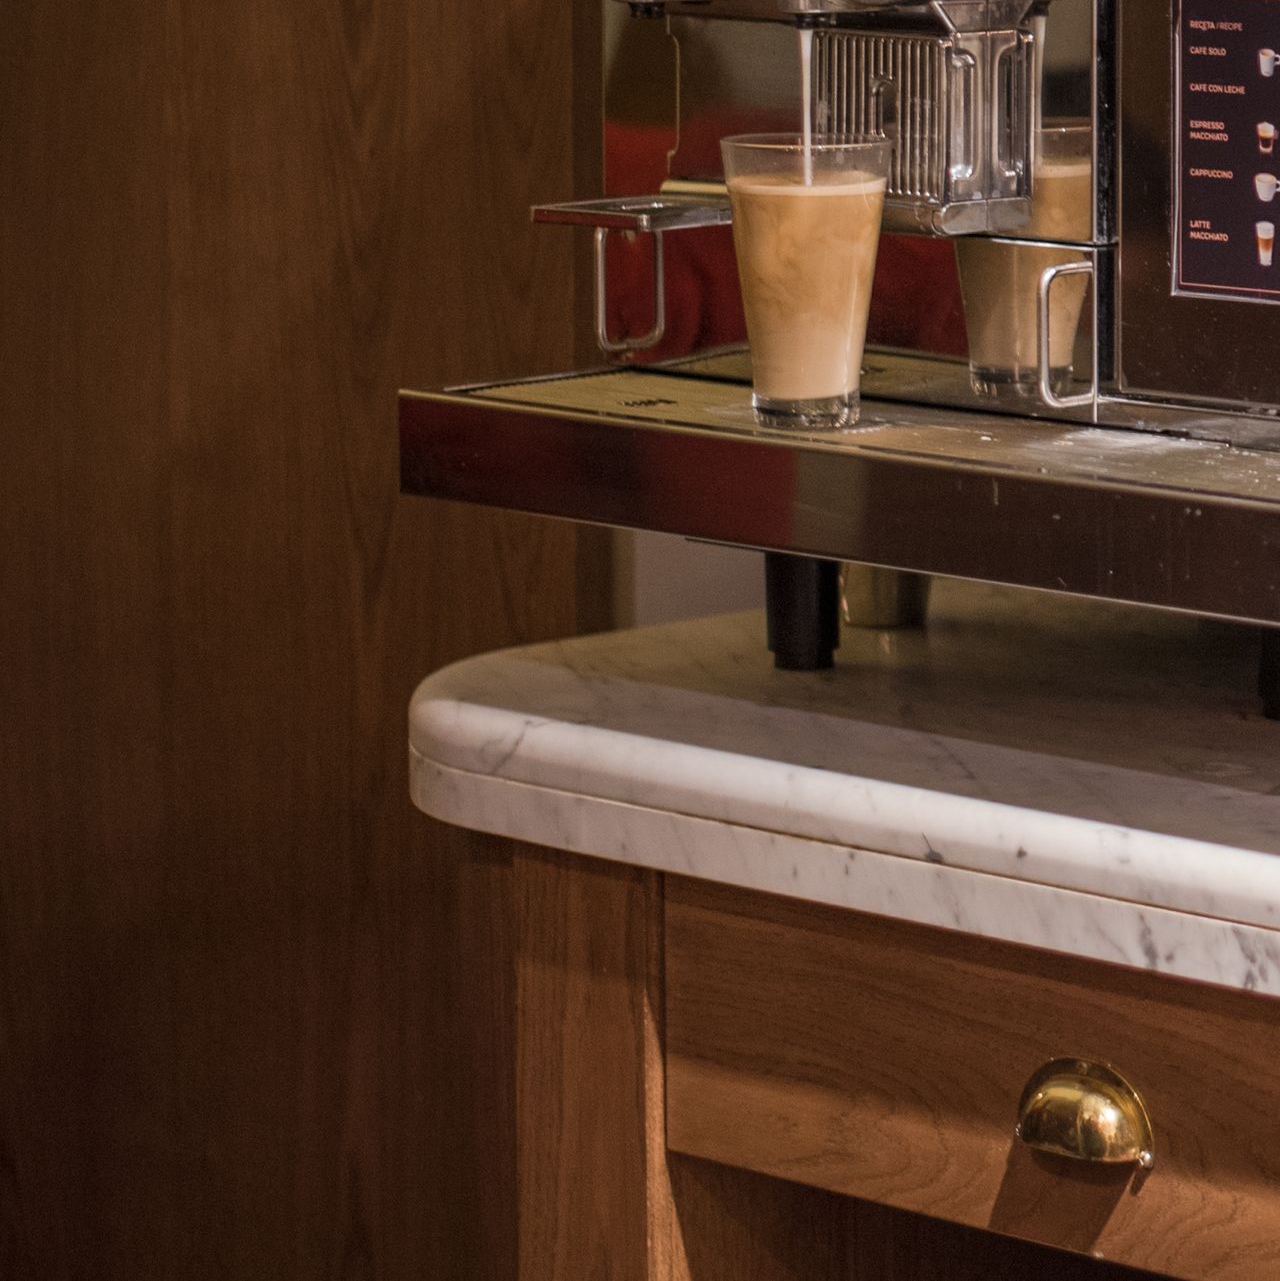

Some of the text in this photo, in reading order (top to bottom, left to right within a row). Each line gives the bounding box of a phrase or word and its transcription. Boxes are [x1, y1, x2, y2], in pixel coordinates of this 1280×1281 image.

[1190, 120, 1225, 130] ESPRESSO
[1190, 132, 1229, 142] MACCHIATO
[1190, 168, 1234, 179] CAPPUCCINO
[1190, 220, 1211, 229] LATTE
[1190, 231, 1229, 242] MACCHIATO
